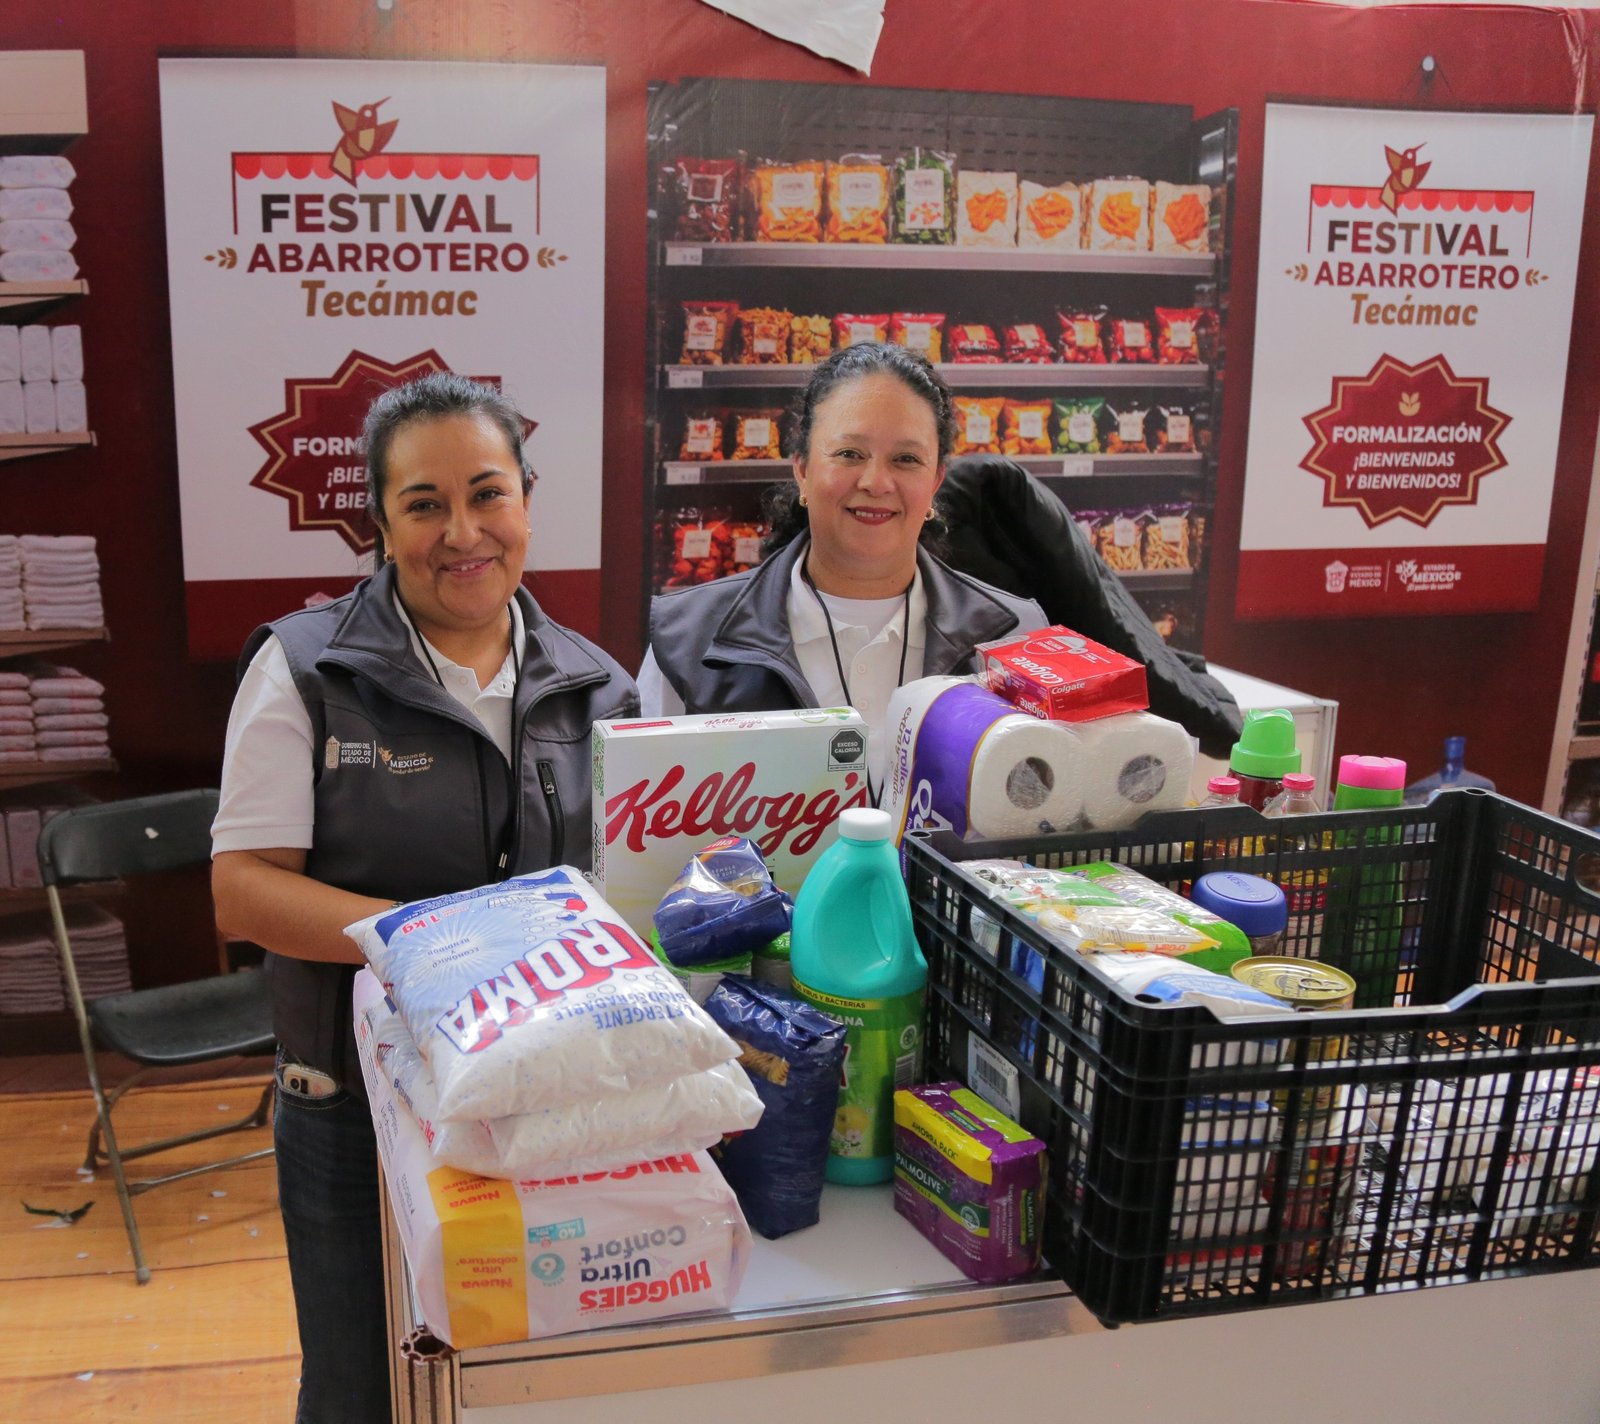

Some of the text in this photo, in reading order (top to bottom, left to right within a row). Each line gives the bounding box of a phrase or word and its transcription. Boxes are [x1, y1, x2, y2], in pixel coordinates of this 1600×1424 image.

[261, 193, 512, 234] FESTIVAL
[1327, 220, 1509, 257] FESTIVAL
[246, 242, 530, 273] ABARROTERO
[1314, 261, 1520, 289] ABARROTERO
[301, 279, 478, 317] Tecámac
[1350, 293, 1479, 327] Tecámac
[1332, 421, 1482, 444] FORMALIZACIÓN
[1353, 452, 1456, 472] ¡BIENVENIDAS
[1345, 473, 1461, 490] Y BIENVENIDOS!
[317, 493, 330, 509] Y
[1011, 656, 1064, 685] Colgate
[1051, 681, 1086, 695] Colgate
[1020, 697, 1050, 721] Colgate
[704, 716, 763, 729] Kellgg's
[899, 727, 912, 796] 12 rollos
[401, 918, 426, 935] kg
[436, 918, 642, 1055] ROMA
[803, 987, 819, 999] VIRUS
[825, 997, 866, 1009] BACTERIAS
[824, 1011, 864, 1027] ZANA
[912, 1121, 938, 1147] AHORRA
[939, 1140, 957, 1160] PACK
[896, 1152, 942, 1194] PALMOLIVE
[449, 1189, 501, 1208] Nueva
[580, 1224, 687, 1264] Confort
[471, 1265, 502, 1274] Ultra
[580, 1257, 652, 1283] Ultra
[460, 1278, 514, 1290] Nueva
[578, 1260, 712, 1311] HUGGIES
